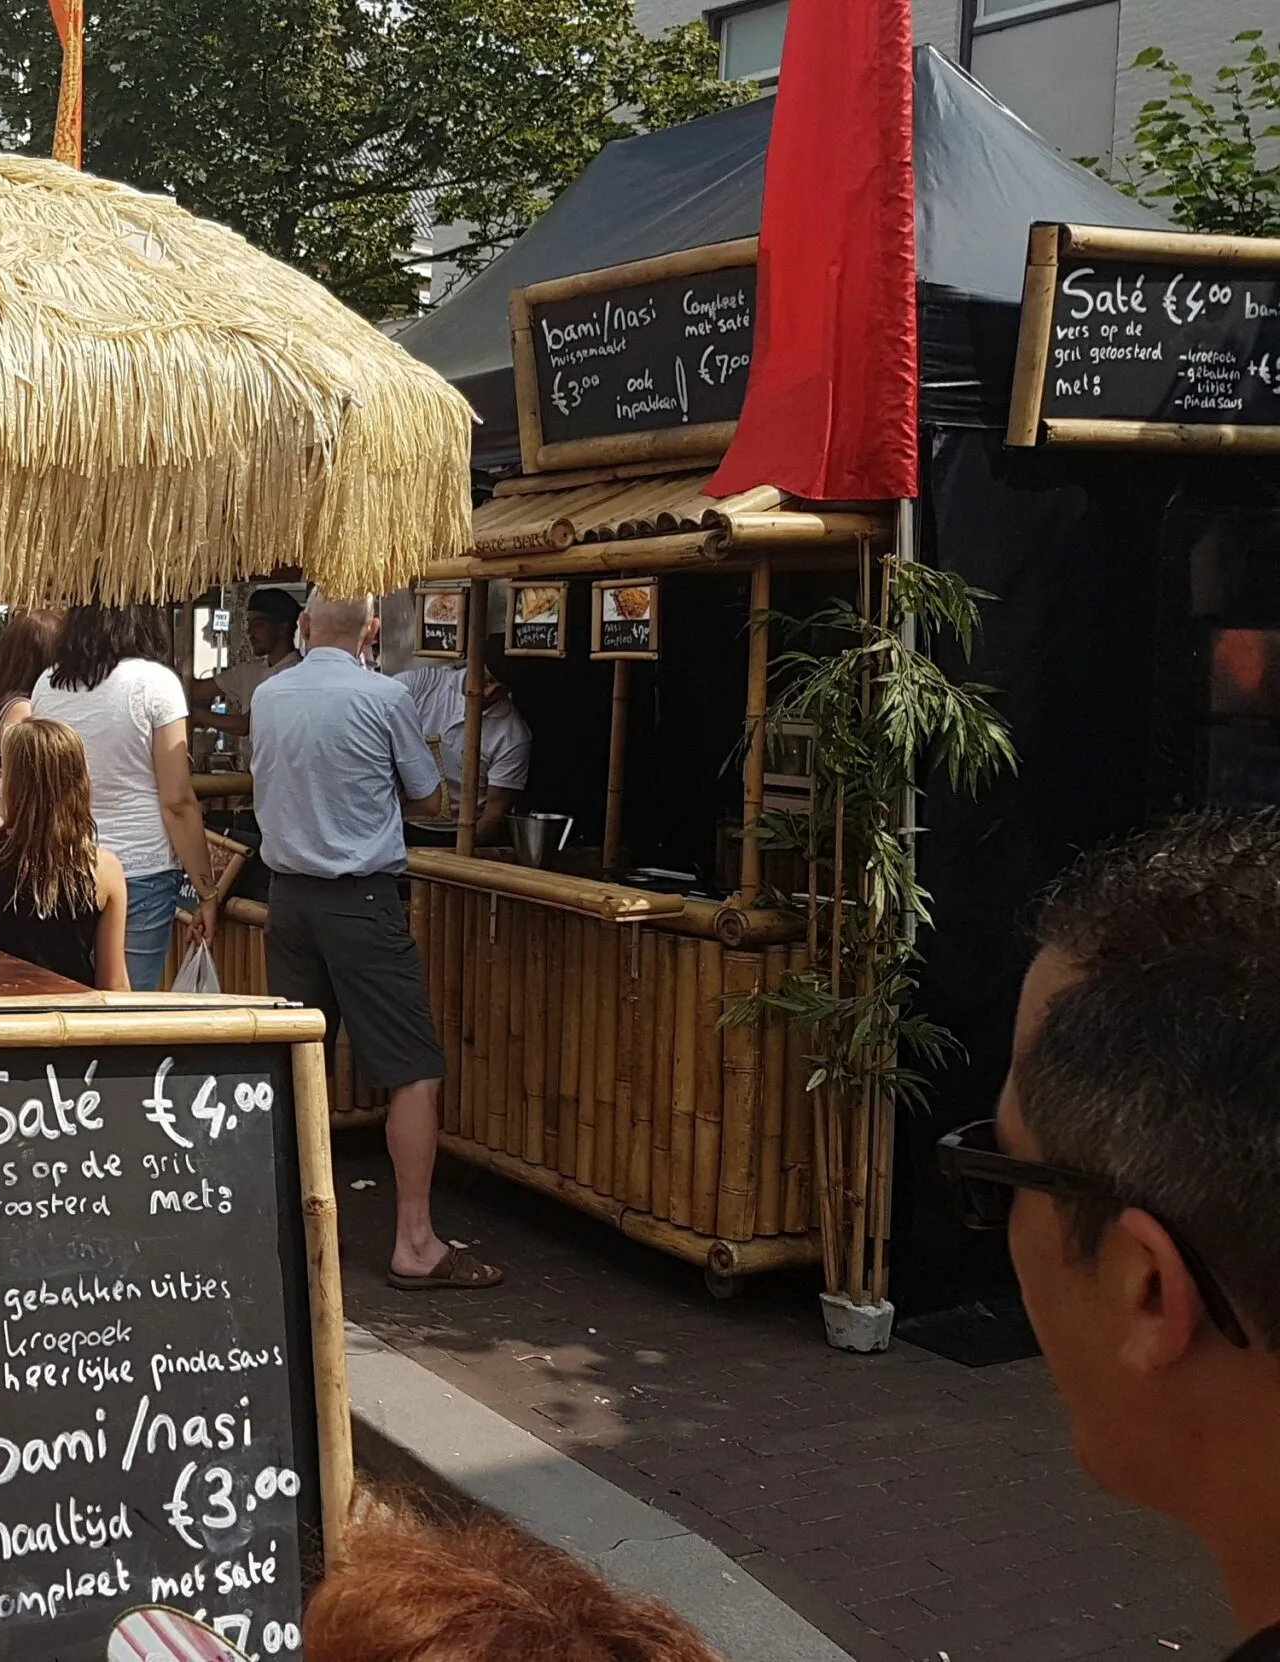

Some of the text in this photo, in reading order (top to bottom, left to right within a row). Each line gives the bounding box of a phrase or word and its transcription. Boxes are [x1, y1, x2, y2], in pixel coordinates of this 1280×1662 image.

[1062, 267, 1146, 319] Saté
[685, 309, 750, 338] met saté
[1056, 321, 1142, 342] vers op de
[551, 338, 627, 368] huisgemaakt
[1054, 342, 1163, 368] gril geroosterd
[627, 368, 653, 393] ook
[1198, 380, 1233, 396] uitjes
[32, 1162, 68, 1186] op
[81, 1150, 123, 1180] de
[142, 1153, 197, 1179] gril
[4, 1274, 141, 1321] gebakken
[151, 1270, 232, 1300] uitjes
[4, 1320, 132, 1358] kroepoek
[152, 1564, 205, 1602] met
[215, 1540, 276, 1595] saté
